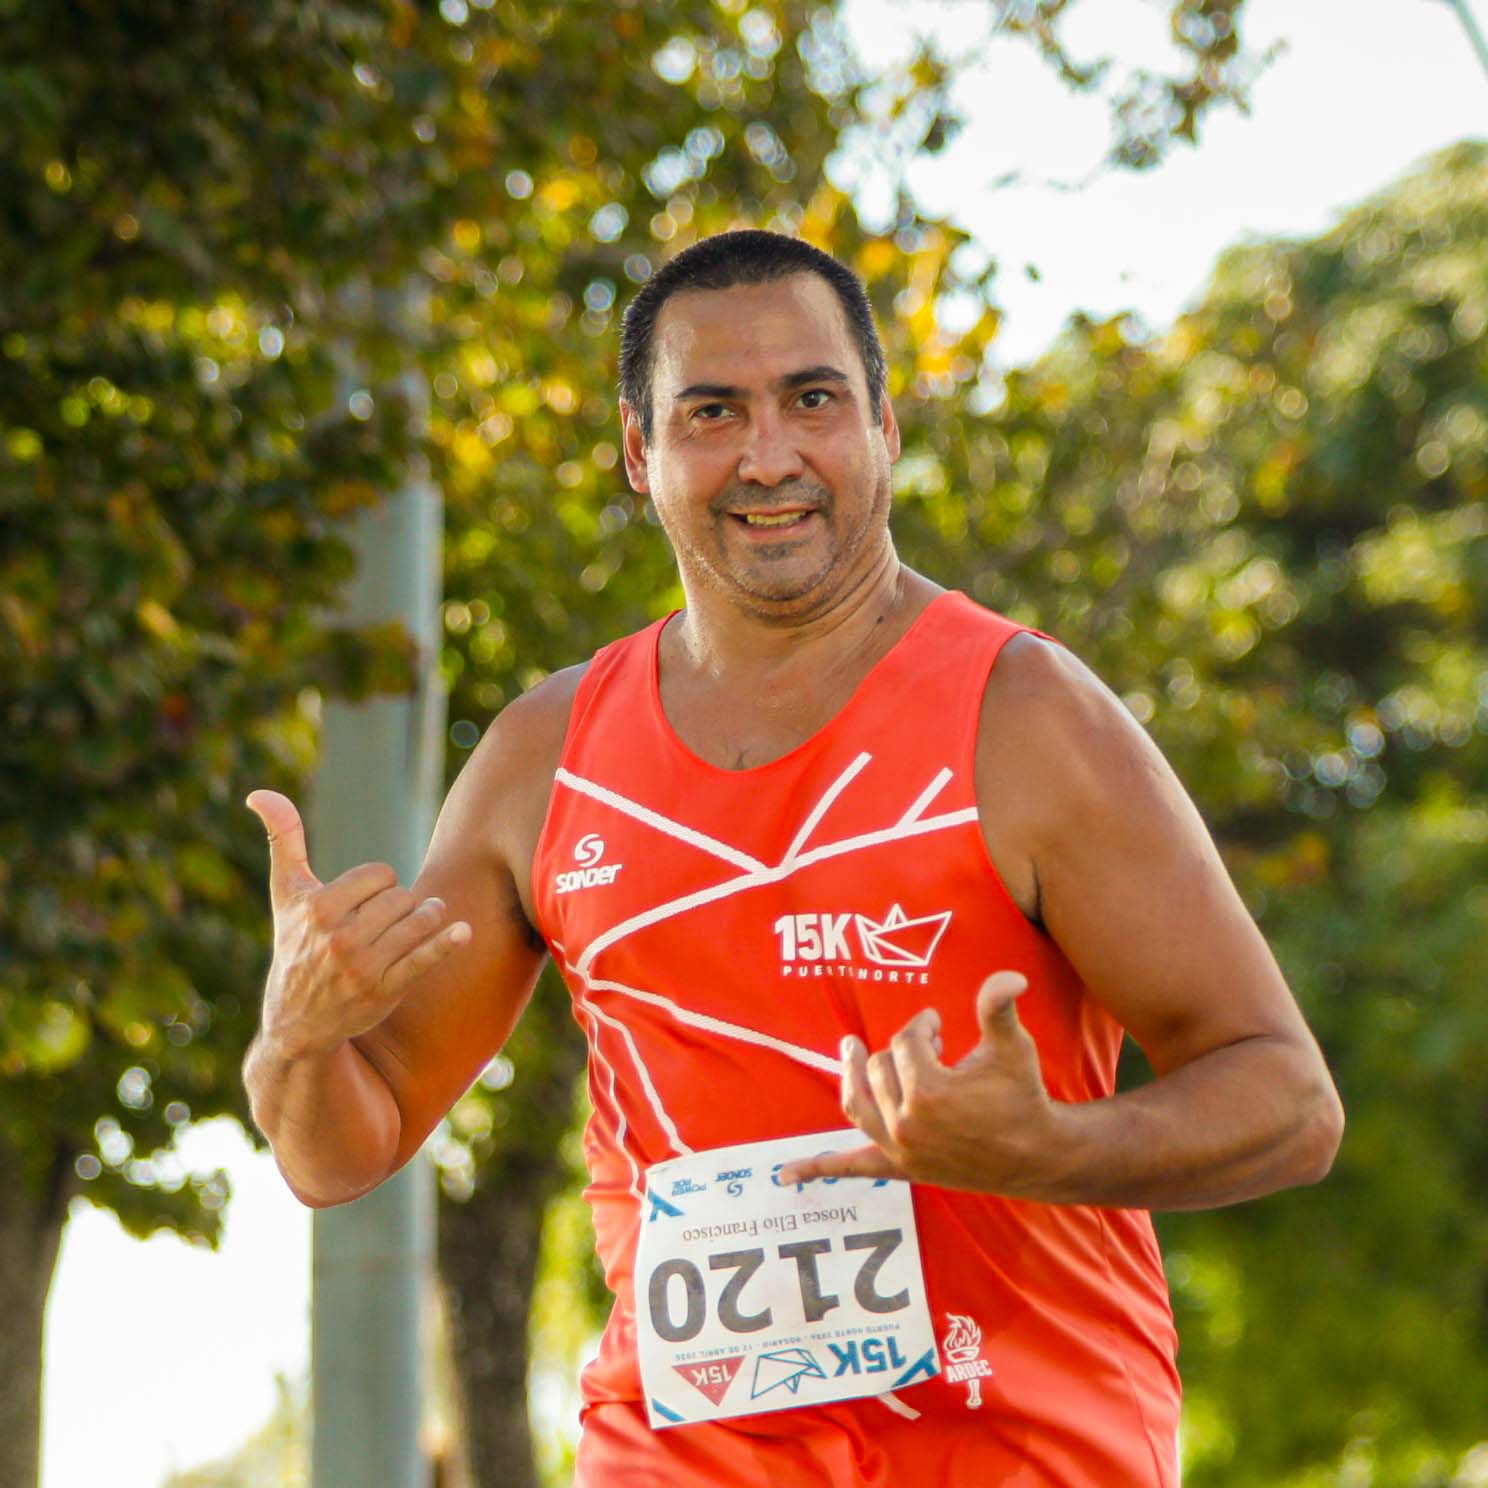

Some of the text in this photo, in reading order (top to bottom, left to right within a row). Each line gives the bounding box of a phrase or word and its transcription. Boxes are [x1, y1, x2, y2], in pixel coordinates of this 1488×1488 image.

[774, 912, 852, 961] 15K
[858, 968, 929, 985] NORTE
[682, 1206, 857, 1242] Mosca Elio Francisco
[648, 1228, 910, 1343] 2120
[827, 1335, 907, 1376] 15K
[691, 1364, 732, 1387] 15K
